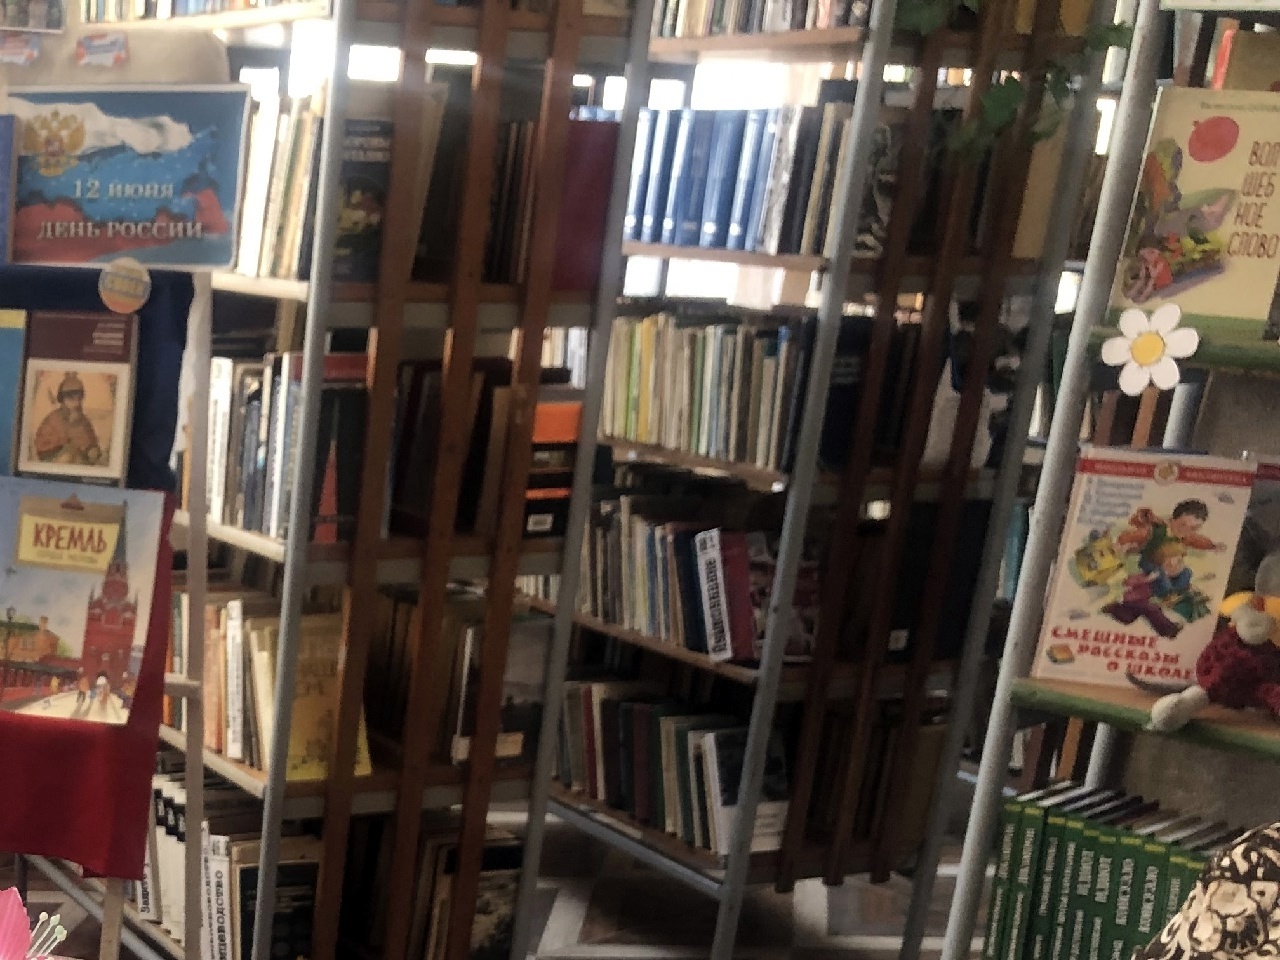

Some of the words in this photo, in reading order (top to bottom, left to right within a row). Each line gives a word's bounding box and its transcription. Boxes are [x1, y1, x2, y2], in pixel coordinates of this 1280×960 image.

[74, 178, 101, 199] 12
[108, 181, 174, 199] июня
[1241, 171, 1277, 198] ШЕБ
[1234, 202, 1268, 229] НОЕ
[36, 221, 101, 240] ДЕНЬ
[107, 221, 204, 239] РОССИИ
[1227, 231, 1280, 259] СЛОВО
[33, 522, 107, 554] КРЕМЛЬ
